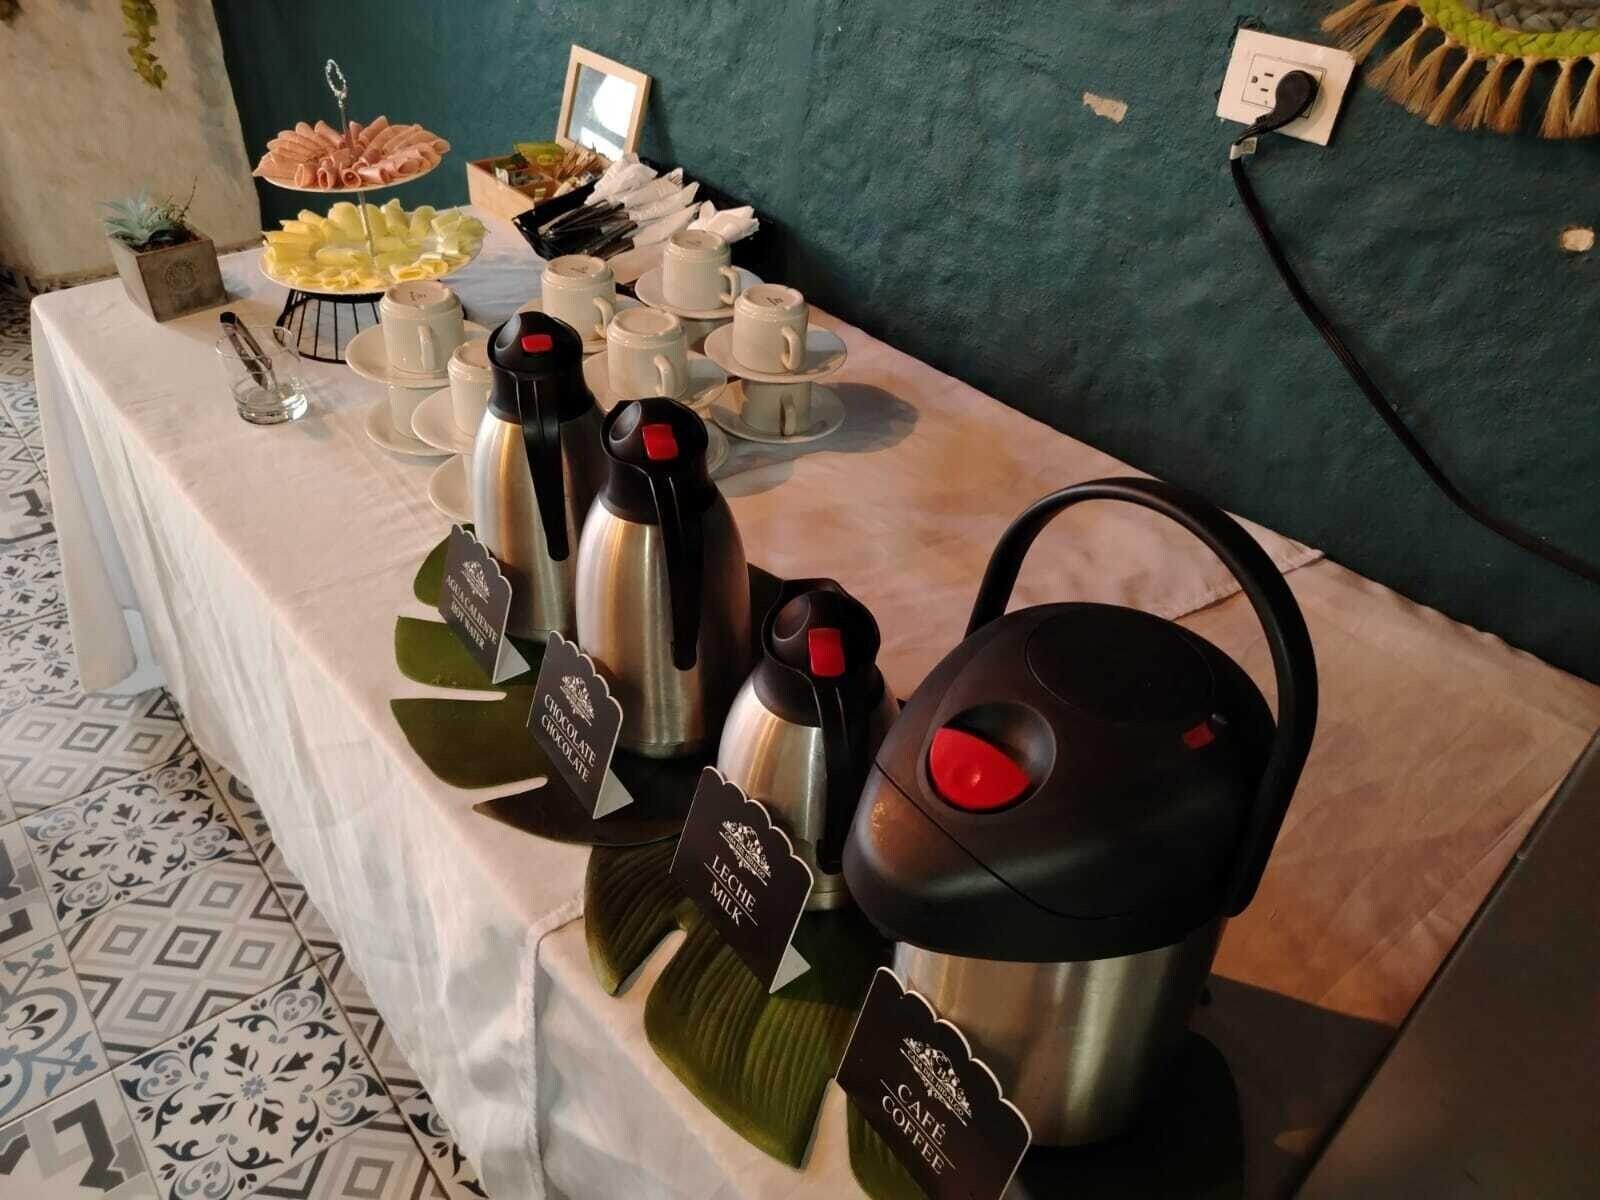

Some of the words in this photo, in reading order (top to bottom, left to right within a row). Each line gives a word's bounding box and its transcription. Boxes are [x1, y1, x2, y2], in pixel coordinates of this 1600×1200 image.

[464, 597, 498, 646] CALIENTE
[541, 714, 590, 783] CHOCOLATE
[544, 694, 597, 769] CHOCOLATE
[710, 881, 743, 928] MILK
[712, 855, 757, 914] LECHE
[882, 1095, 946, 1176] COFFEE
[897, 1084, 947, 1146] CAFÉ
